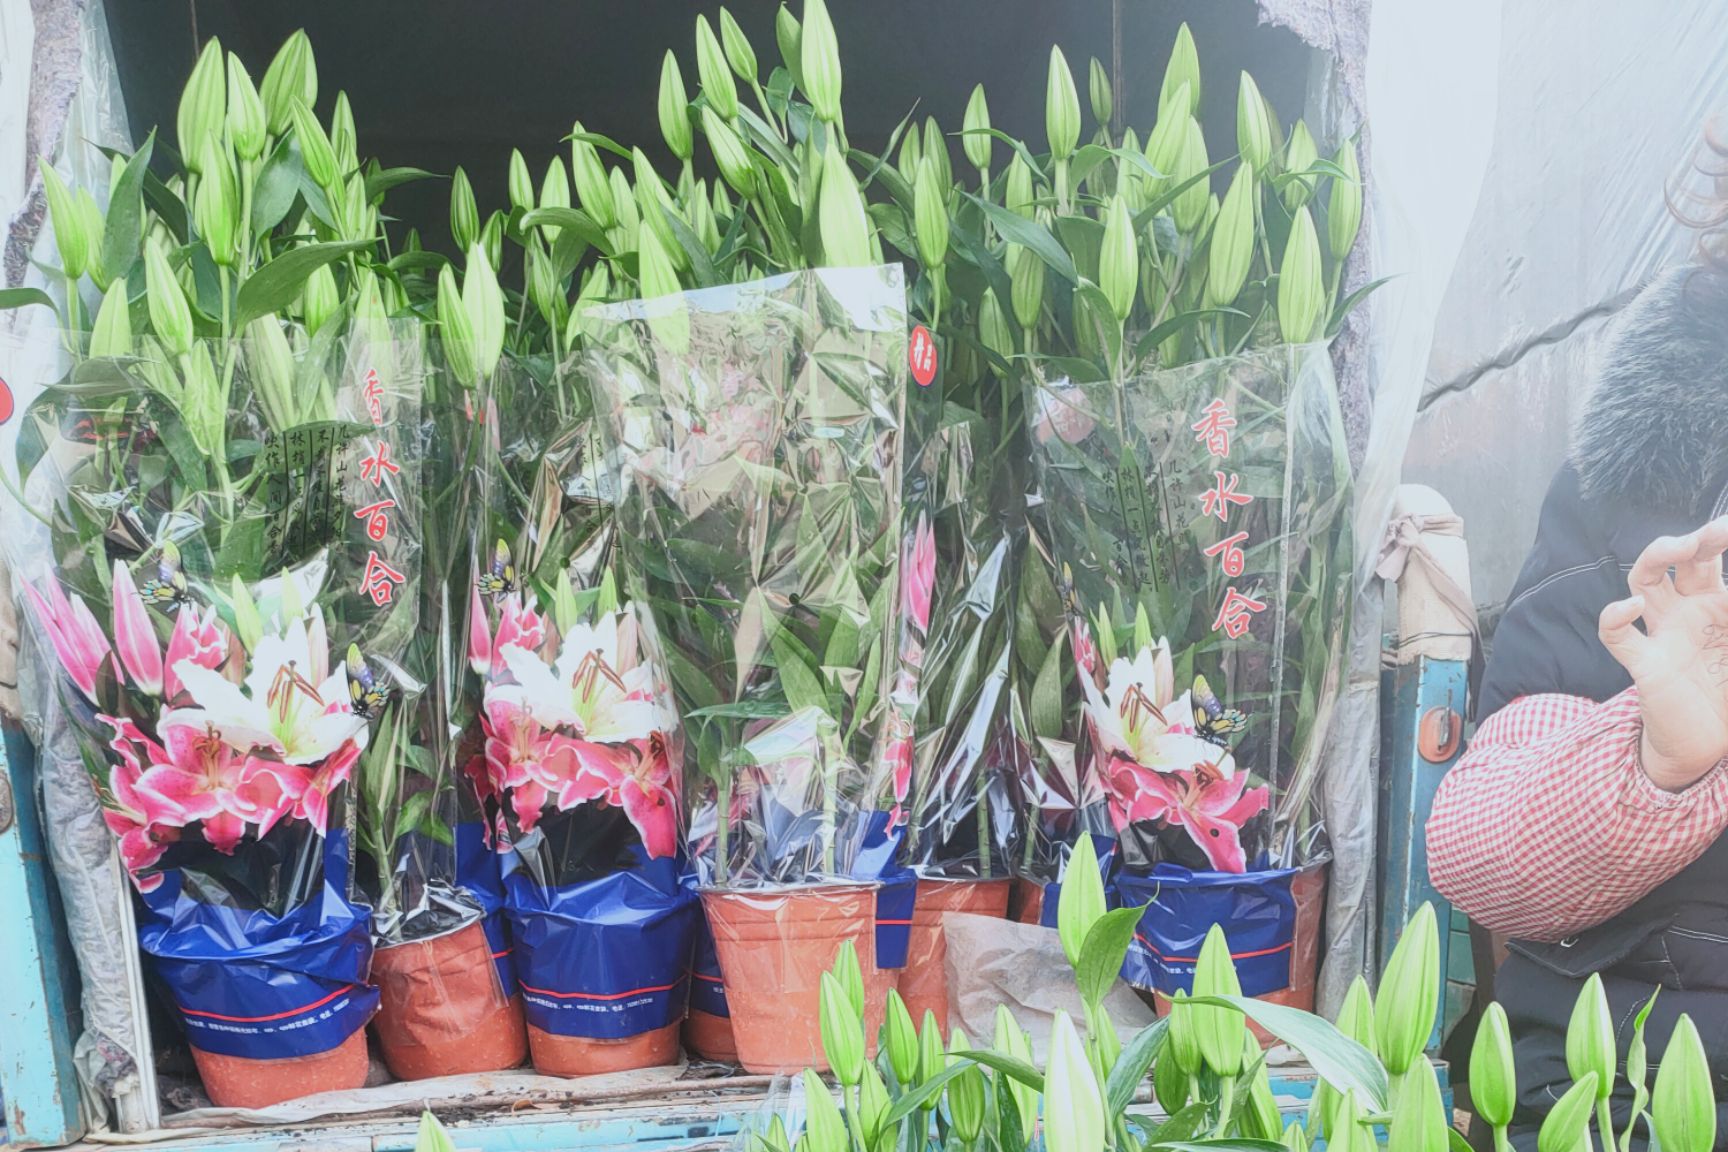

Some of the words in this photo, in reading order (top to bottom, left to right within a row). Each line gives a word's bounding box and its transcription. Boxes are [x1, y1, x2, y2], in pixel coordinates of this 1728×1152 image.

[353, 368, 406, 607] 香水百合
[1190, 397, 1268, 641] 香水百合
